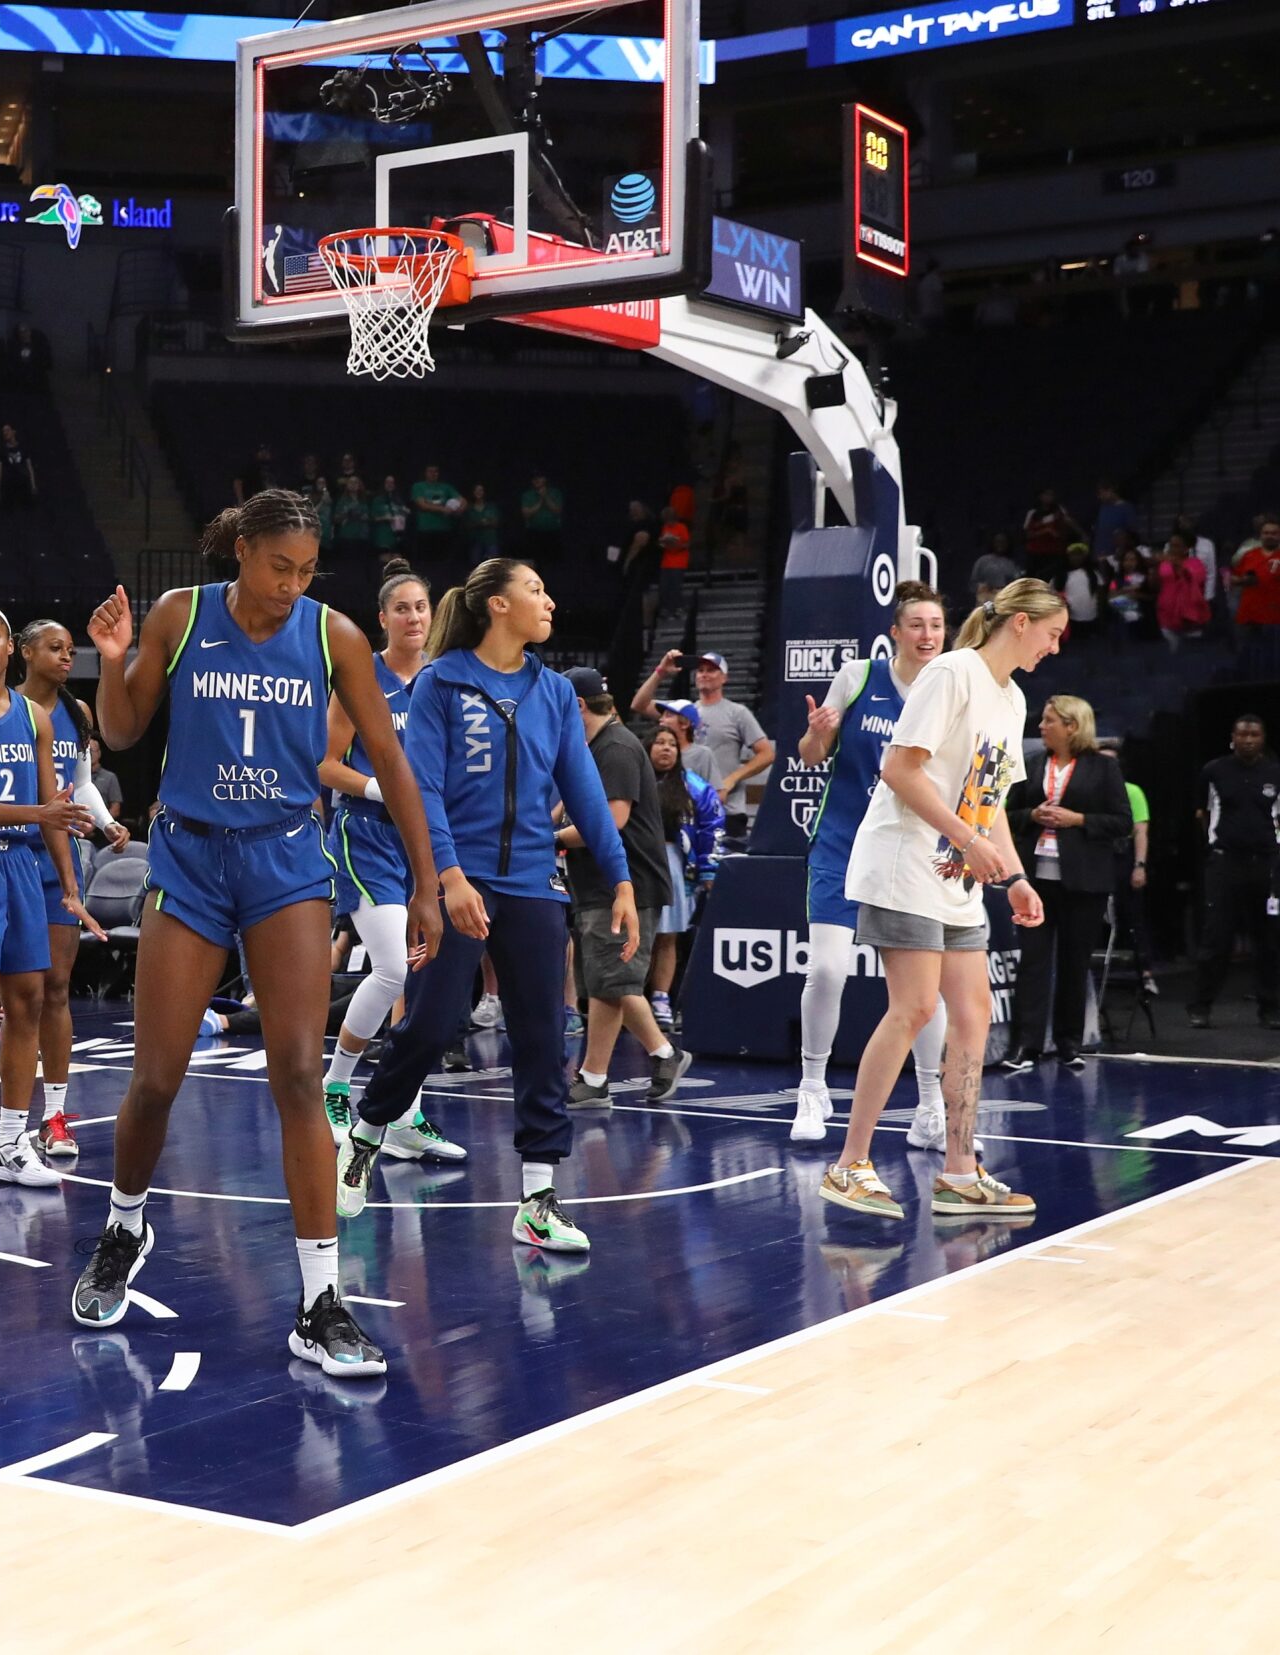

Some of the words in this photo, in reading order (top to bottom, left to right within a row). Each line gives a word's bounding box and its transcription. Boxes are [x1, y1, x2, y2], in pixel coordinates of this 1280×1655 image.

[938, 4, 1019, 36] TAME
[1087, 4, 1115, 20] STL
[1138, 0, 1156, 13] 10
[1121, 169, 1155, 188] 120
[112, 198, 173, 228] Island
[605, 226, 661, 254] AT&T
[713, 219, 790, 273] LYNX
[734, 261, 791, 309] WIN
[193, 671, 313, 707] MINNESOTA
[239, 708, 256, 757] 1
[460, 692, 492, 773] LYNX
[217, 764, 279, 786] MAYO
[721, 939, 774, 972] us
